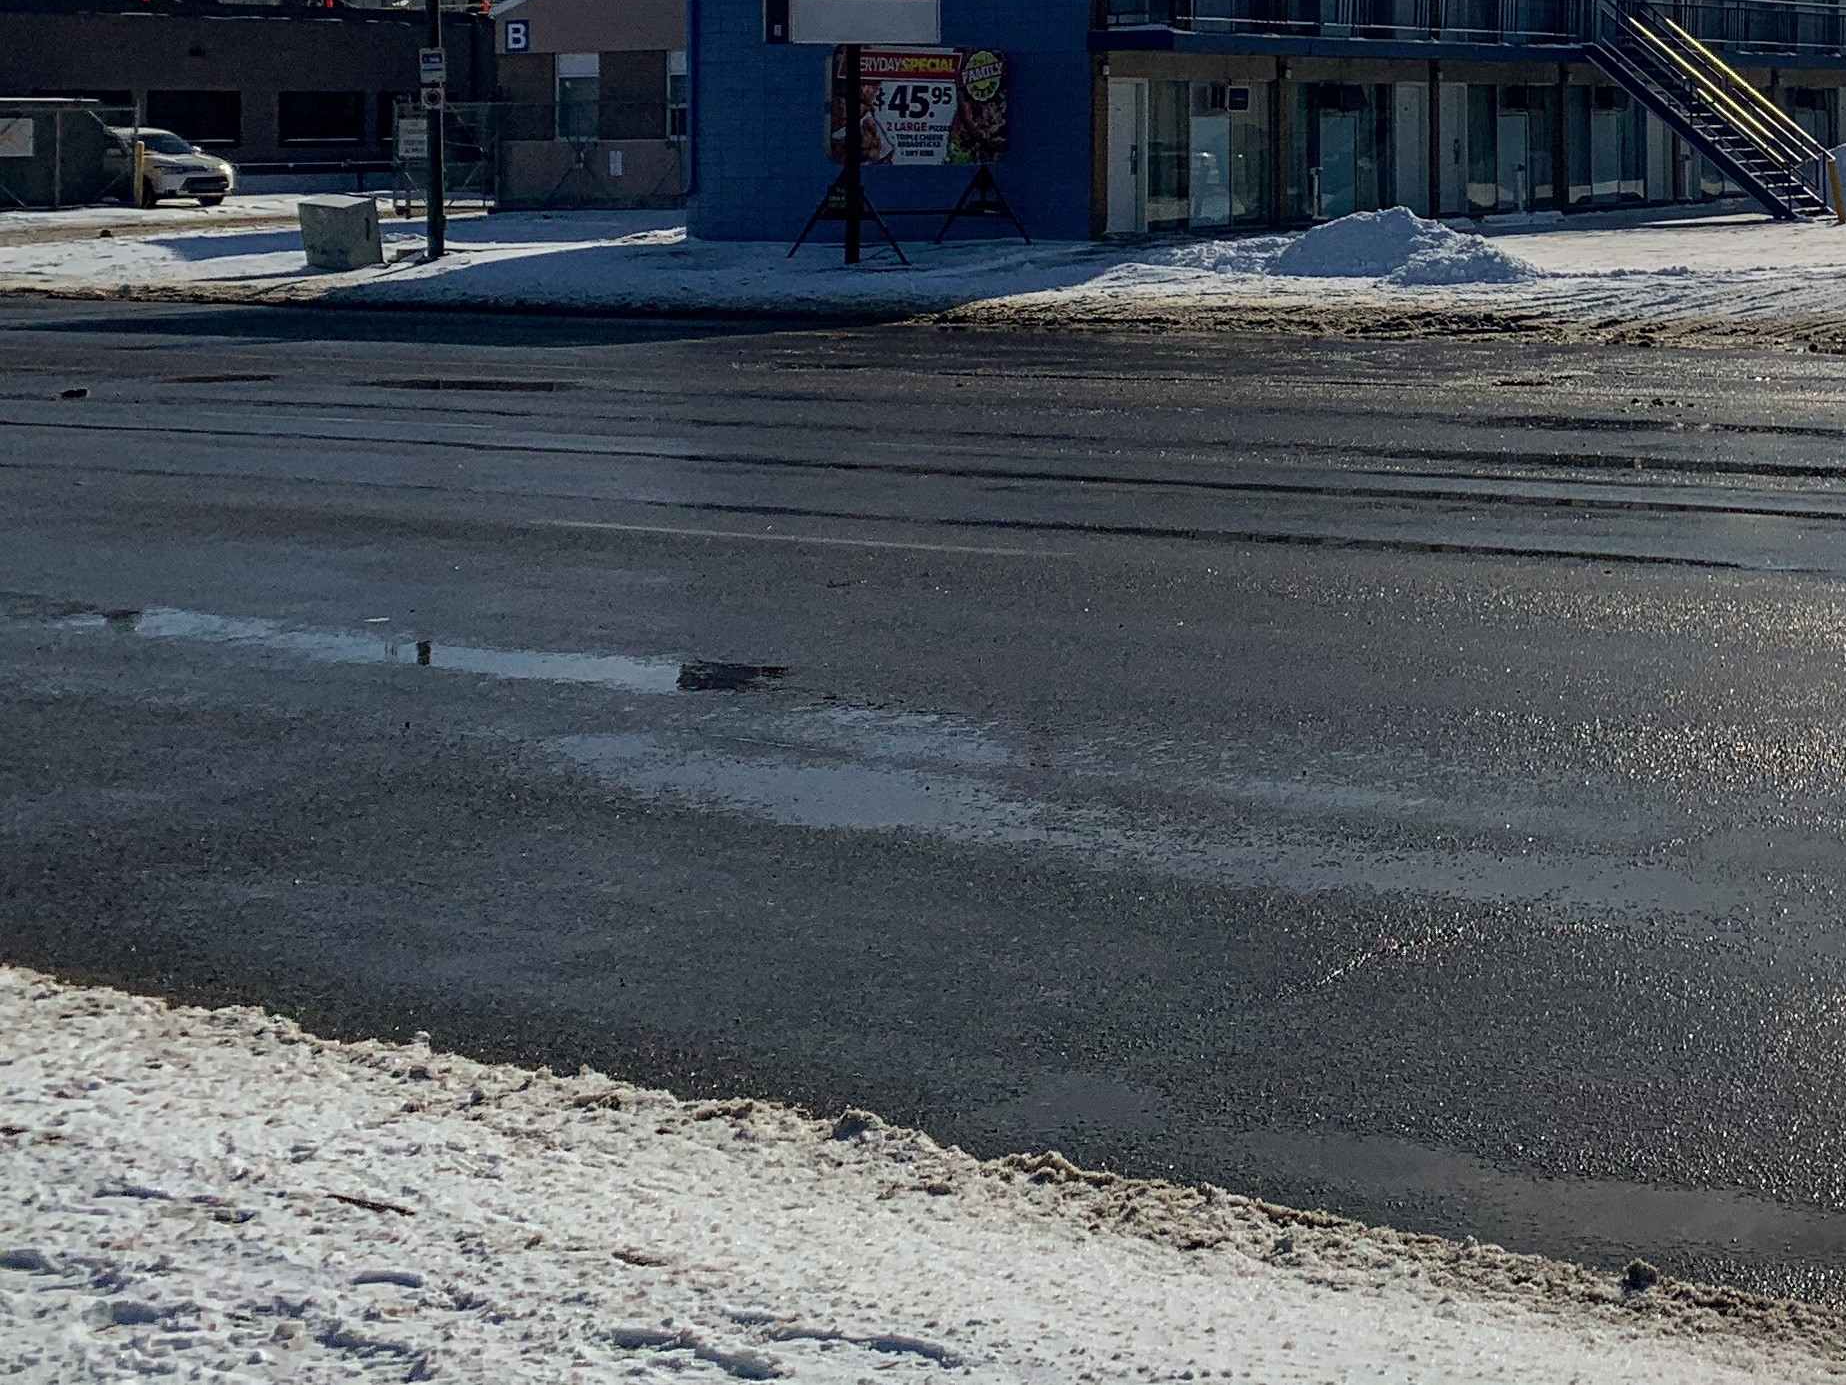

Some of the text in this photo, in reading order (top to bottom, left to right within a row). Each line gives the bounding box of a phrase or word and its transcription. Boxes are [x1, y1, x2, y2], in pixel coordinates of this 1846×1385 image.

[507, 23, 526, 49] B
[860, 56, 902, 72] ERYDAY
[902, 58, 956, 72] SPECIAL
[961, 61, 1004, 85] FAMILY
[894, 122, 927, 132] LARGE
